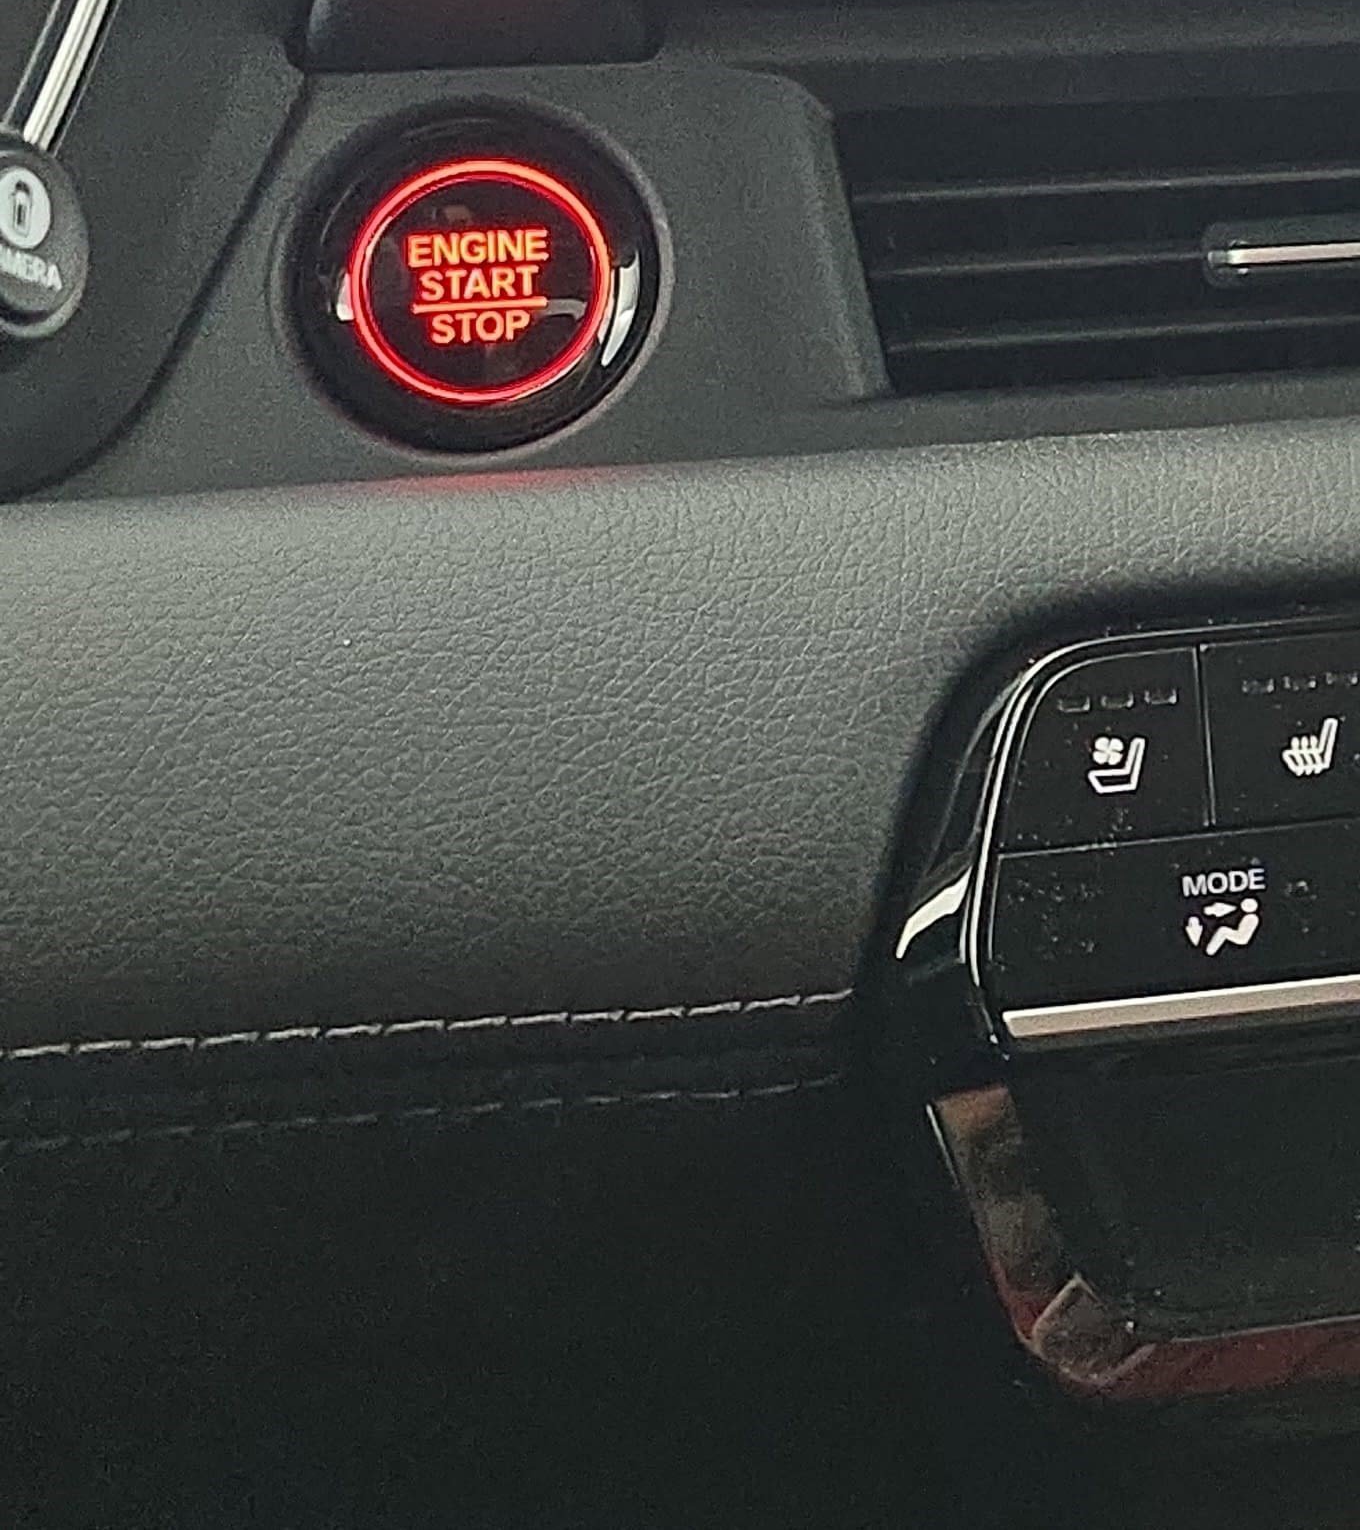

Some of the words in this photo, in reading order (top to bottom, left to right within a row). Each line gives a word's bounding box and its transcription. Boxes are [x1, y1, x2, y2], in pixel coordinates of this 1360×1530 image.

[407, 228, 550, 269] ENGINE
[420, 266, 540, 302] START
[430, 309, 532, 345] STOP
[1181, 866, 1266, 898] MODE
